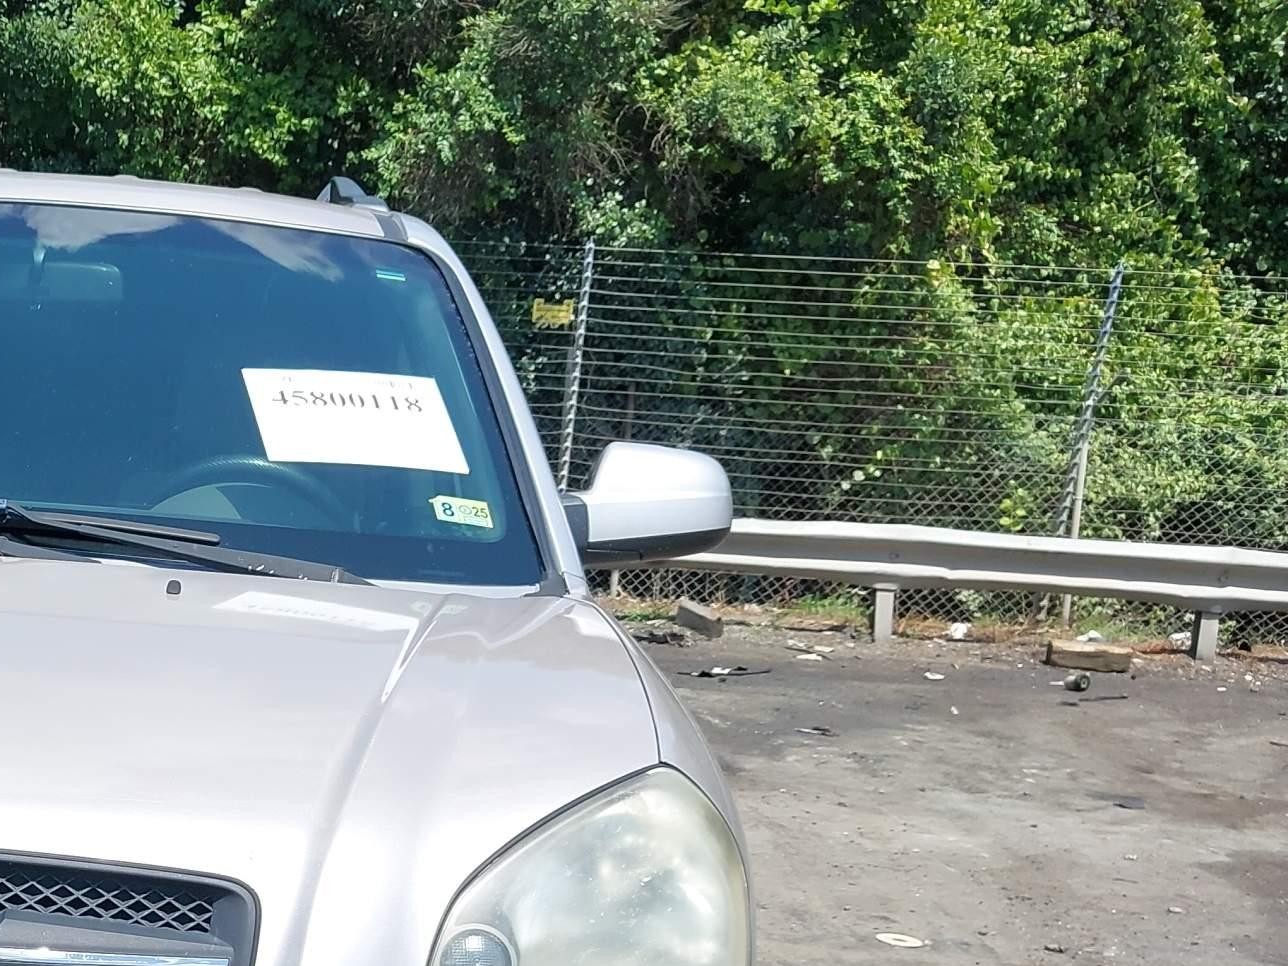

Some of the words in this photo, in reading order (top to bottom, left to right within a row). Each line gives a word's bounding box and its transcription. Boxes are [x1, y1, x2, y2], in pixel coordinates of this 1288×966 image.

[272, 390, 423, 412] 45800118
[441, 502, 455, 517] 8
[472, 506, 489, 519] 25
